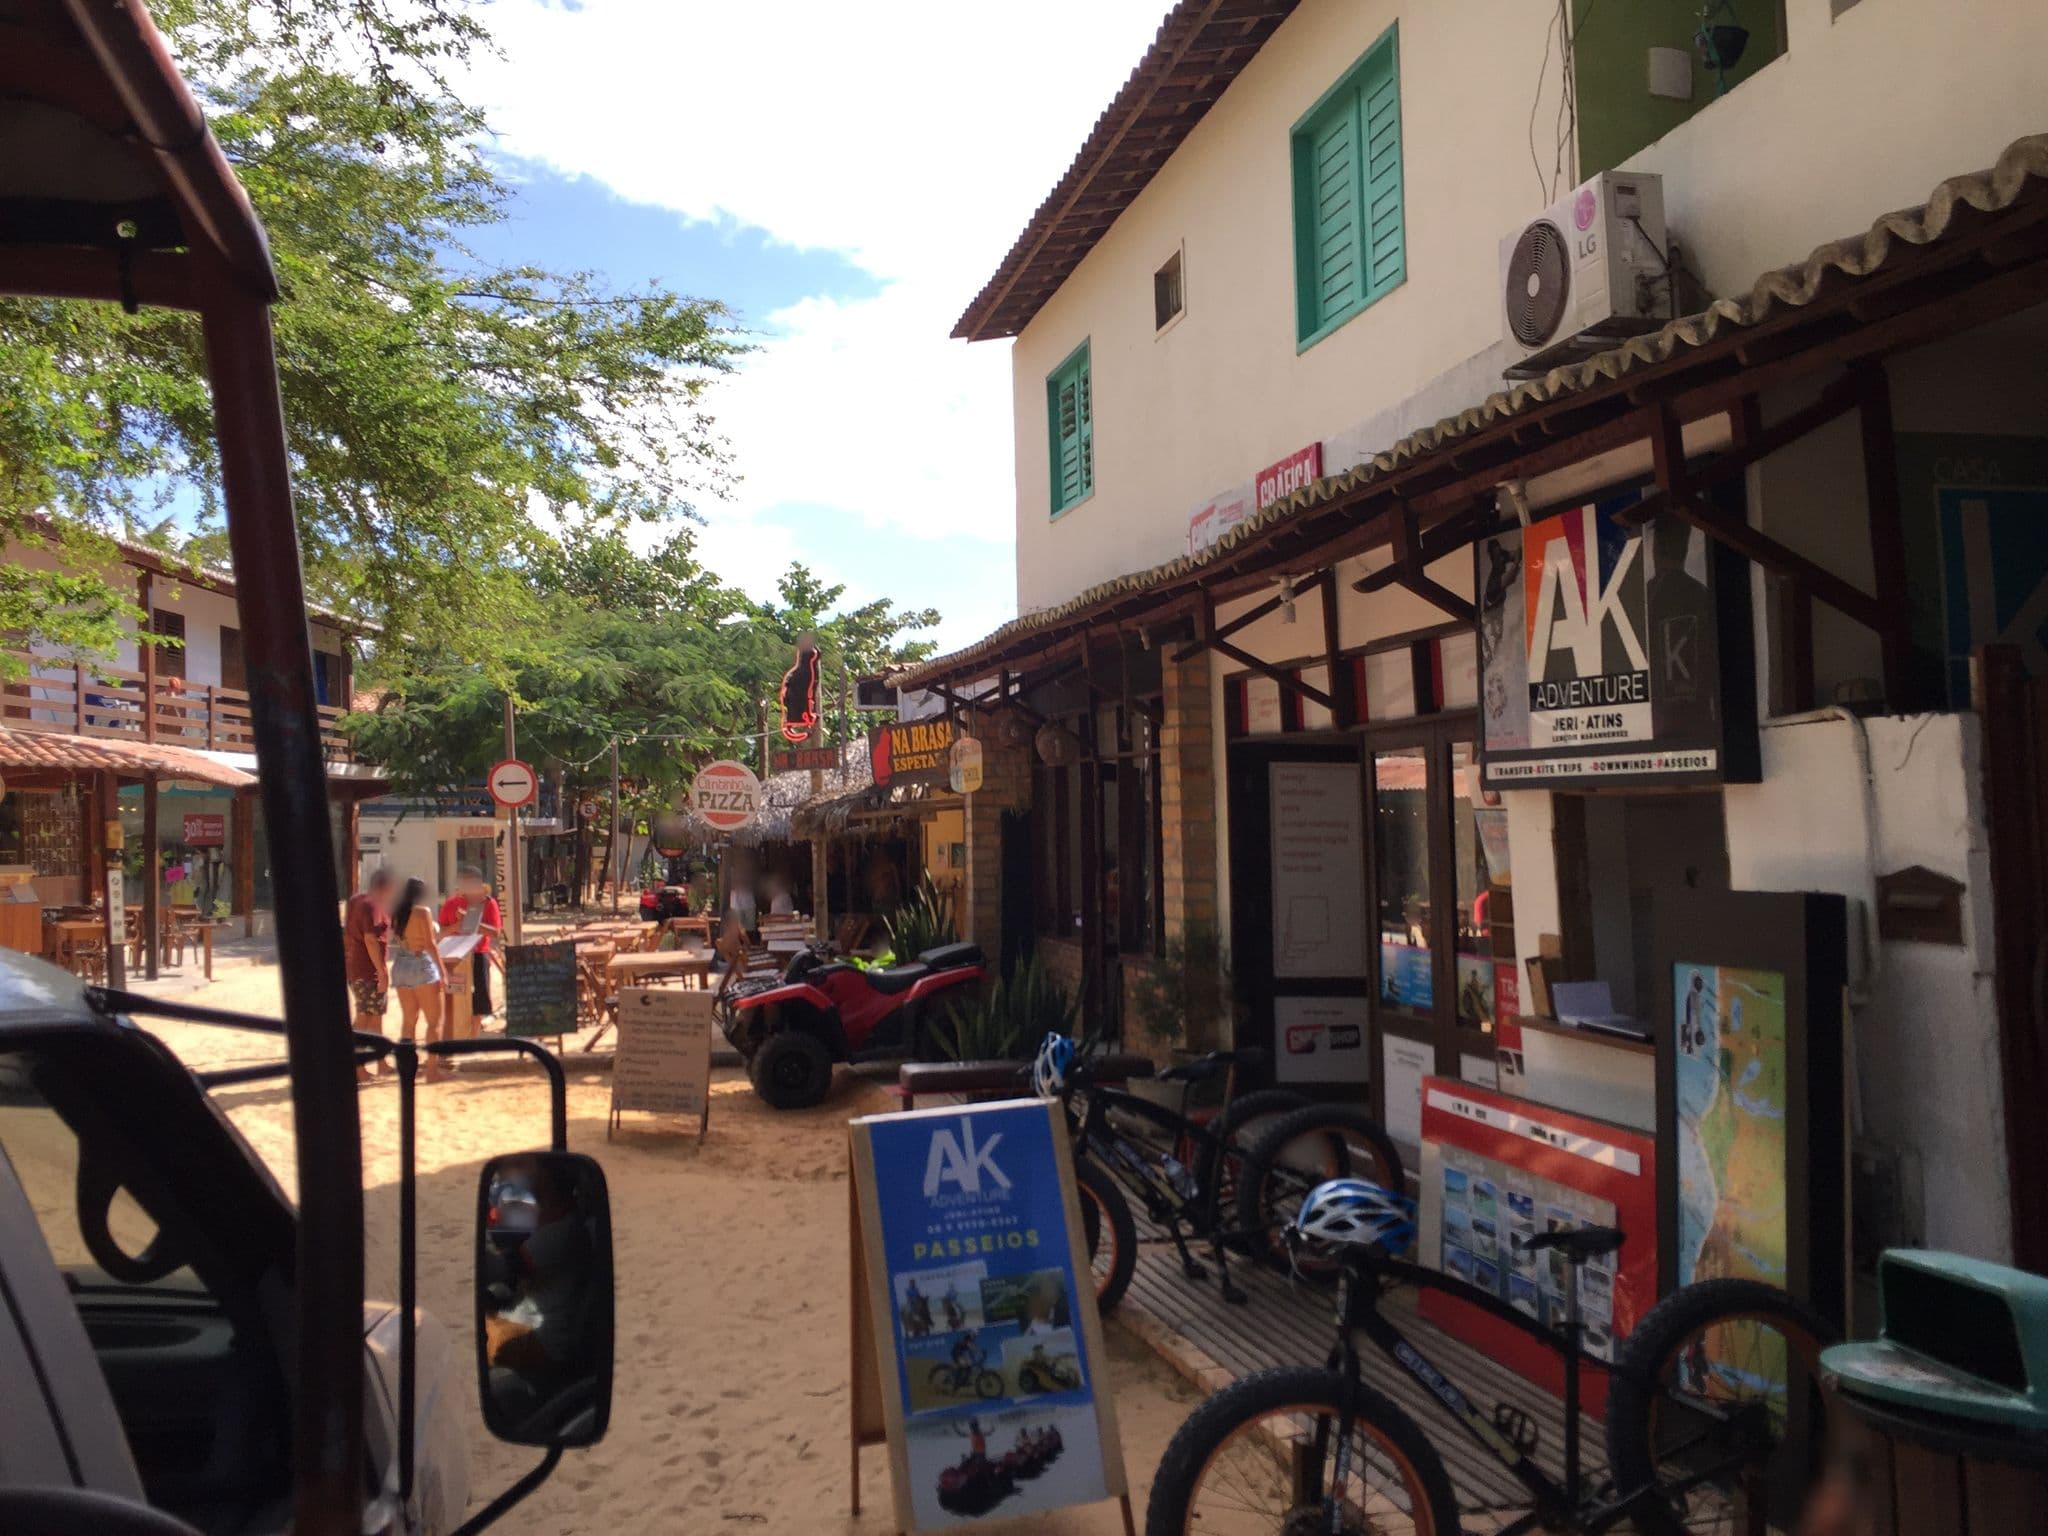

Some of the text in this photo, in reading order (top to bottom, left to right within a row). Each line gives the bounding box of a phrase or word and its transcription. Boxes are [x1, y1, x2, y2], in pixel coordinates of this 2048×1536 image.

[1578, 234, 1598, 259] LG
[1528, 503, 1650, 682] AK
[1535, 673, 1645, 709] ADVENTURE
[1552, 713, 1624, 732] JERI ATINS
[891, 720, 954, 756] NA BRASA
[893, 752, 940, 772] ESPETA
[1557, 762, 1583, 773] TRIPS
[698, 791, 756, 813] PIZZA
[922, 1116, 1013, 1197] AK
[912, 1228, 1040, 1261] PASSEIOS
